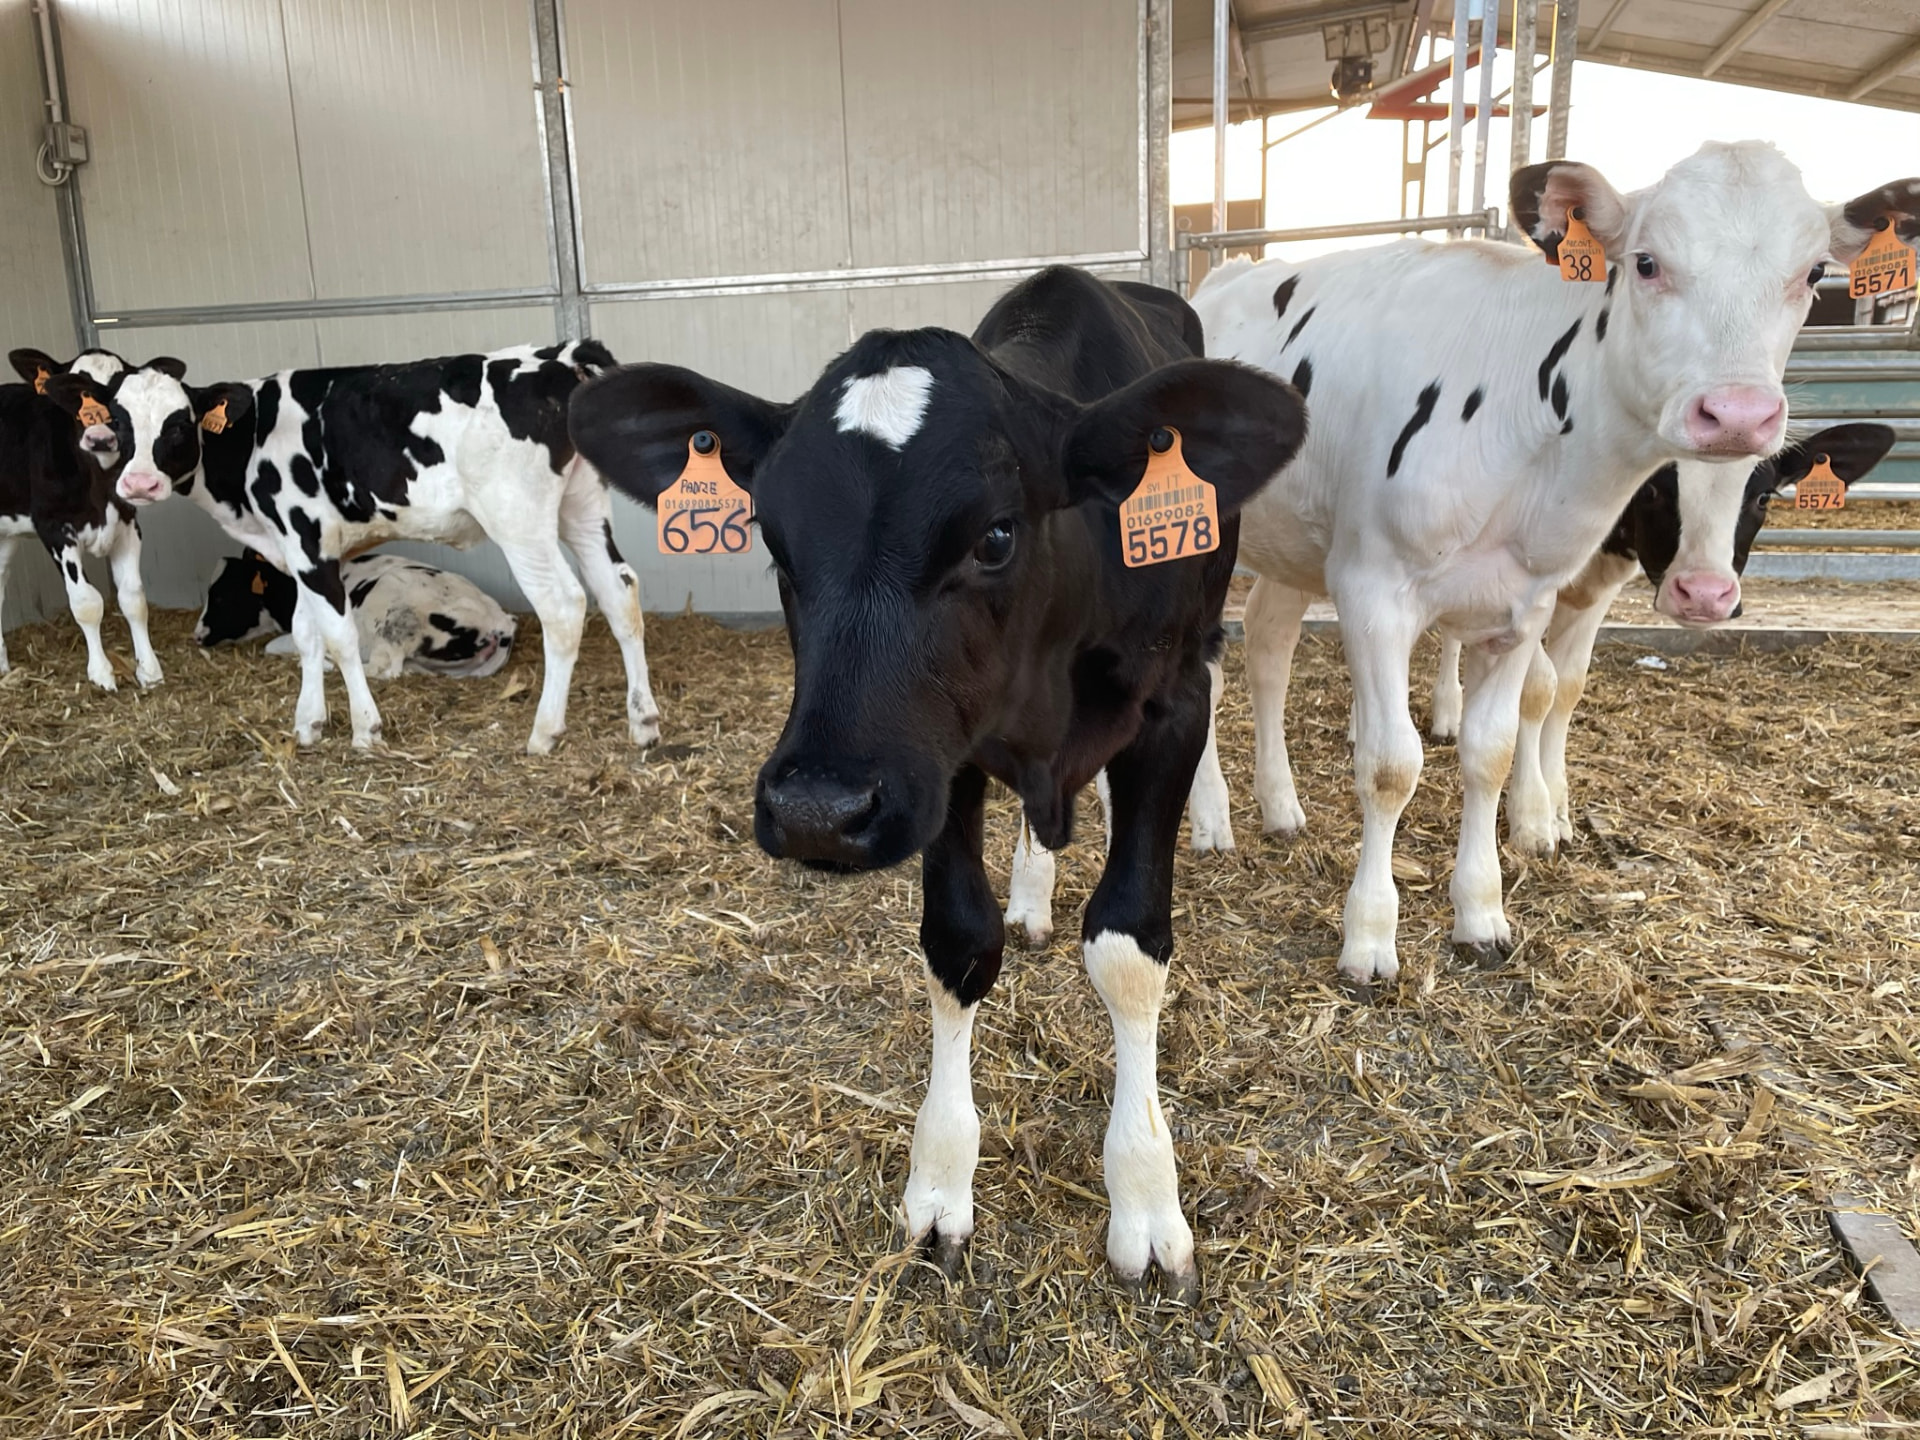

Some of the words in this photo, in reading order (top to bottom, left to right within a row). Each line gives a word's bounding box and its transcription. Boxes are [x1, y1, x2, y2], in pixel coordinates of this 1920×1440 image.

[1563, 254, 1592, 281] 38
[1854, 267, 1908, 297] 5571
[1799, 493, 1841, 509] 5574
[663, 507, 748, 553] 656
[1126, 503, 1205, 529] 01699082
[1128, 515, 1212, 564] 5578
